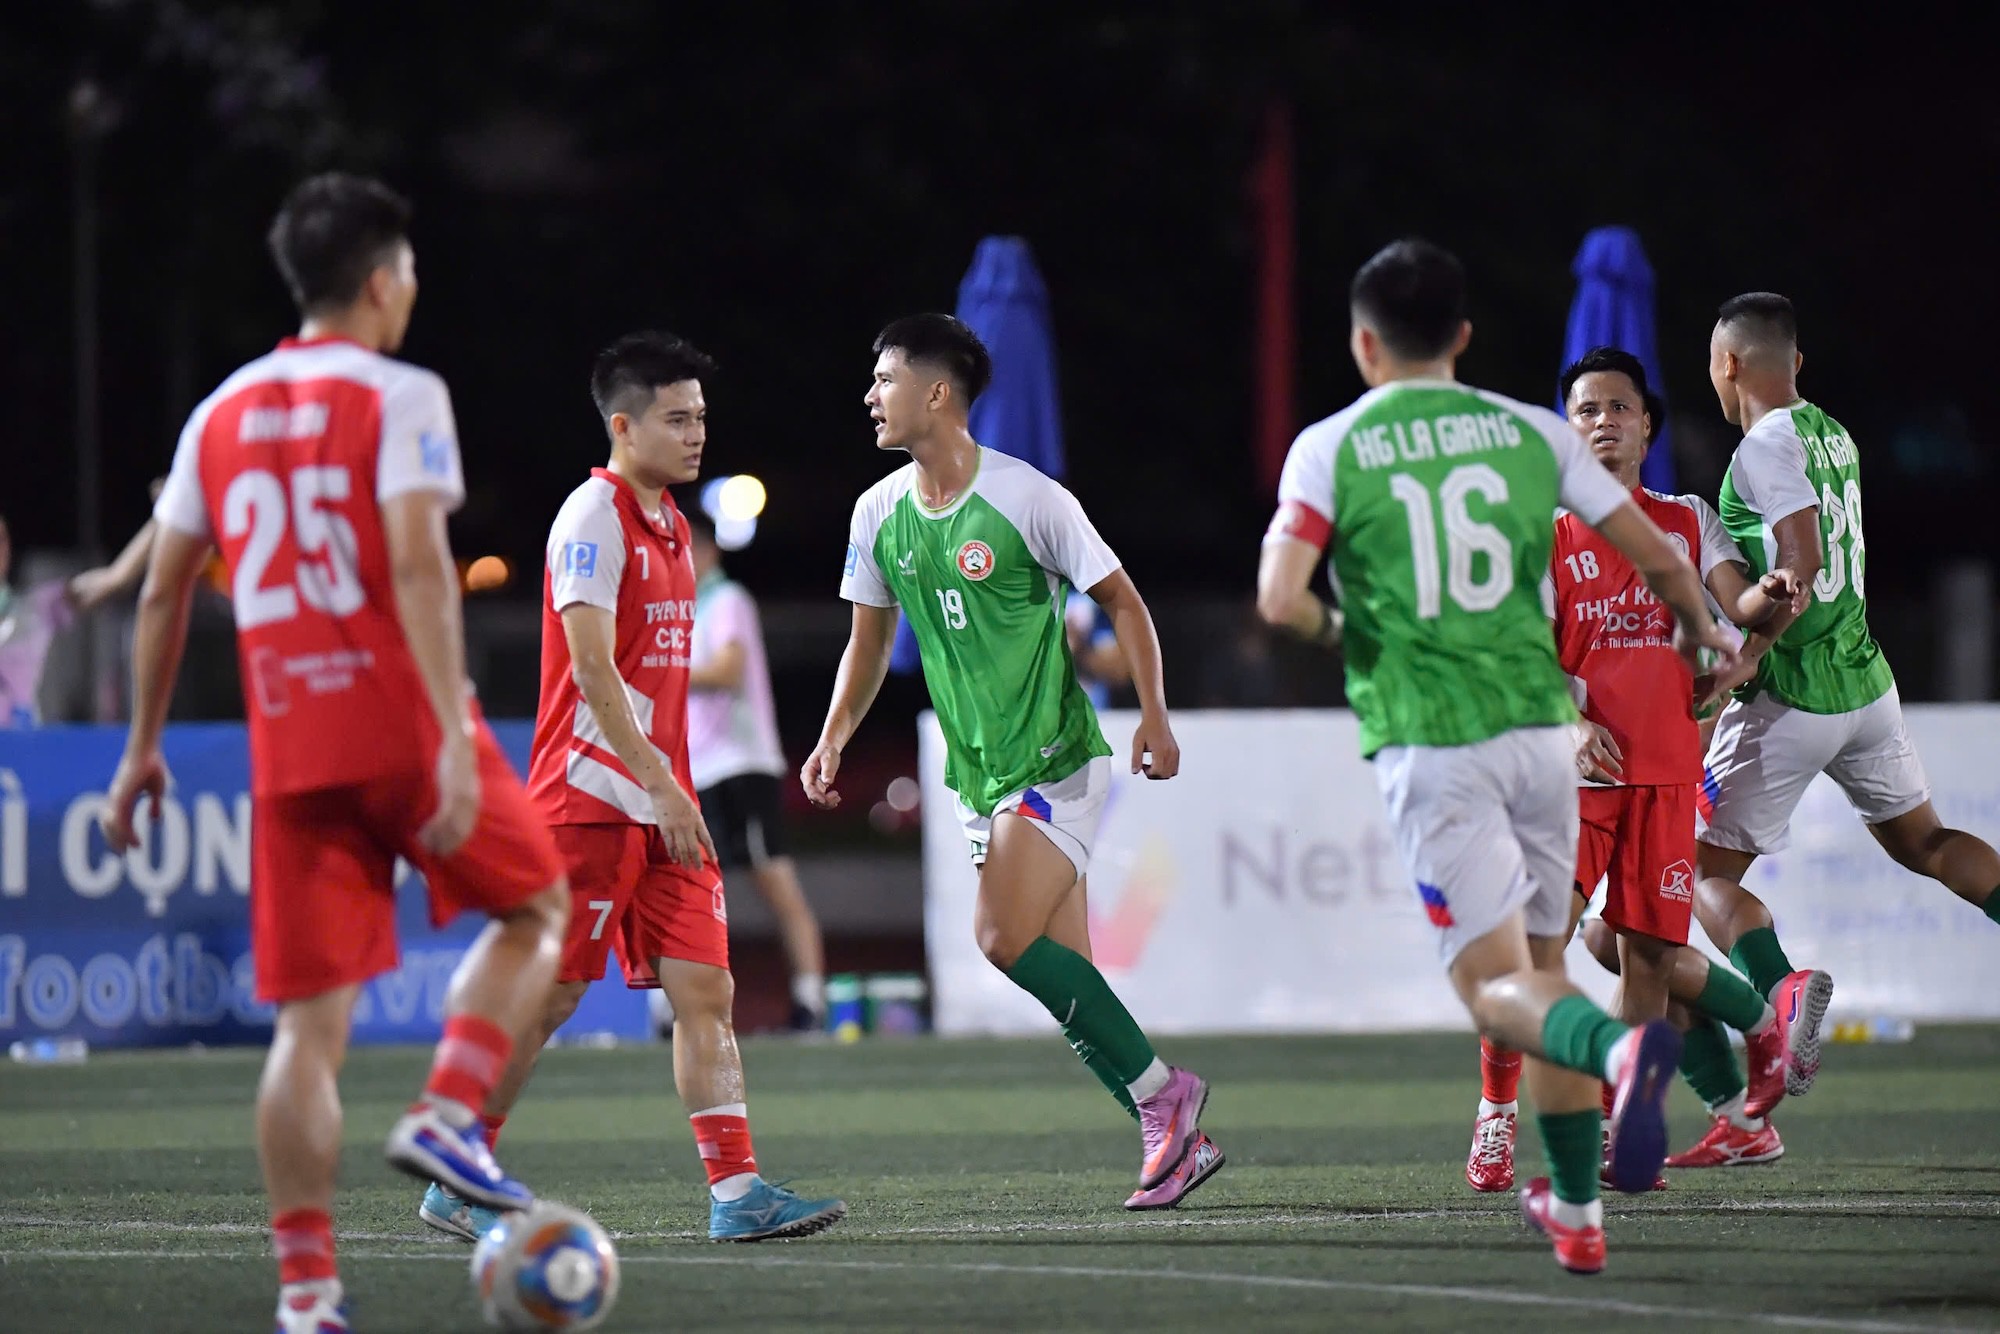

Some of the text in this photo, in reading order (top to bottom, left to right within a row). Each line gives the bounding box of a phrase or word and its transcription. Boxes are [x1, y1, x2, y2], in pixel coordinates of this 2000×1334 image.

[1393, 418, 1436, 462] LA
[223, 465, 366, 630] 25
[1388, 462, 1514, 619] 16
[1812, 478, 1865, 603] 38
[635, 546, 649, 580] 7
[1564, 550, 1600, 584] 18
[936, 589, 967, 630] 19
[1609, 637, 1621, 649] Thi
[588, 900, 614, 940] 7
